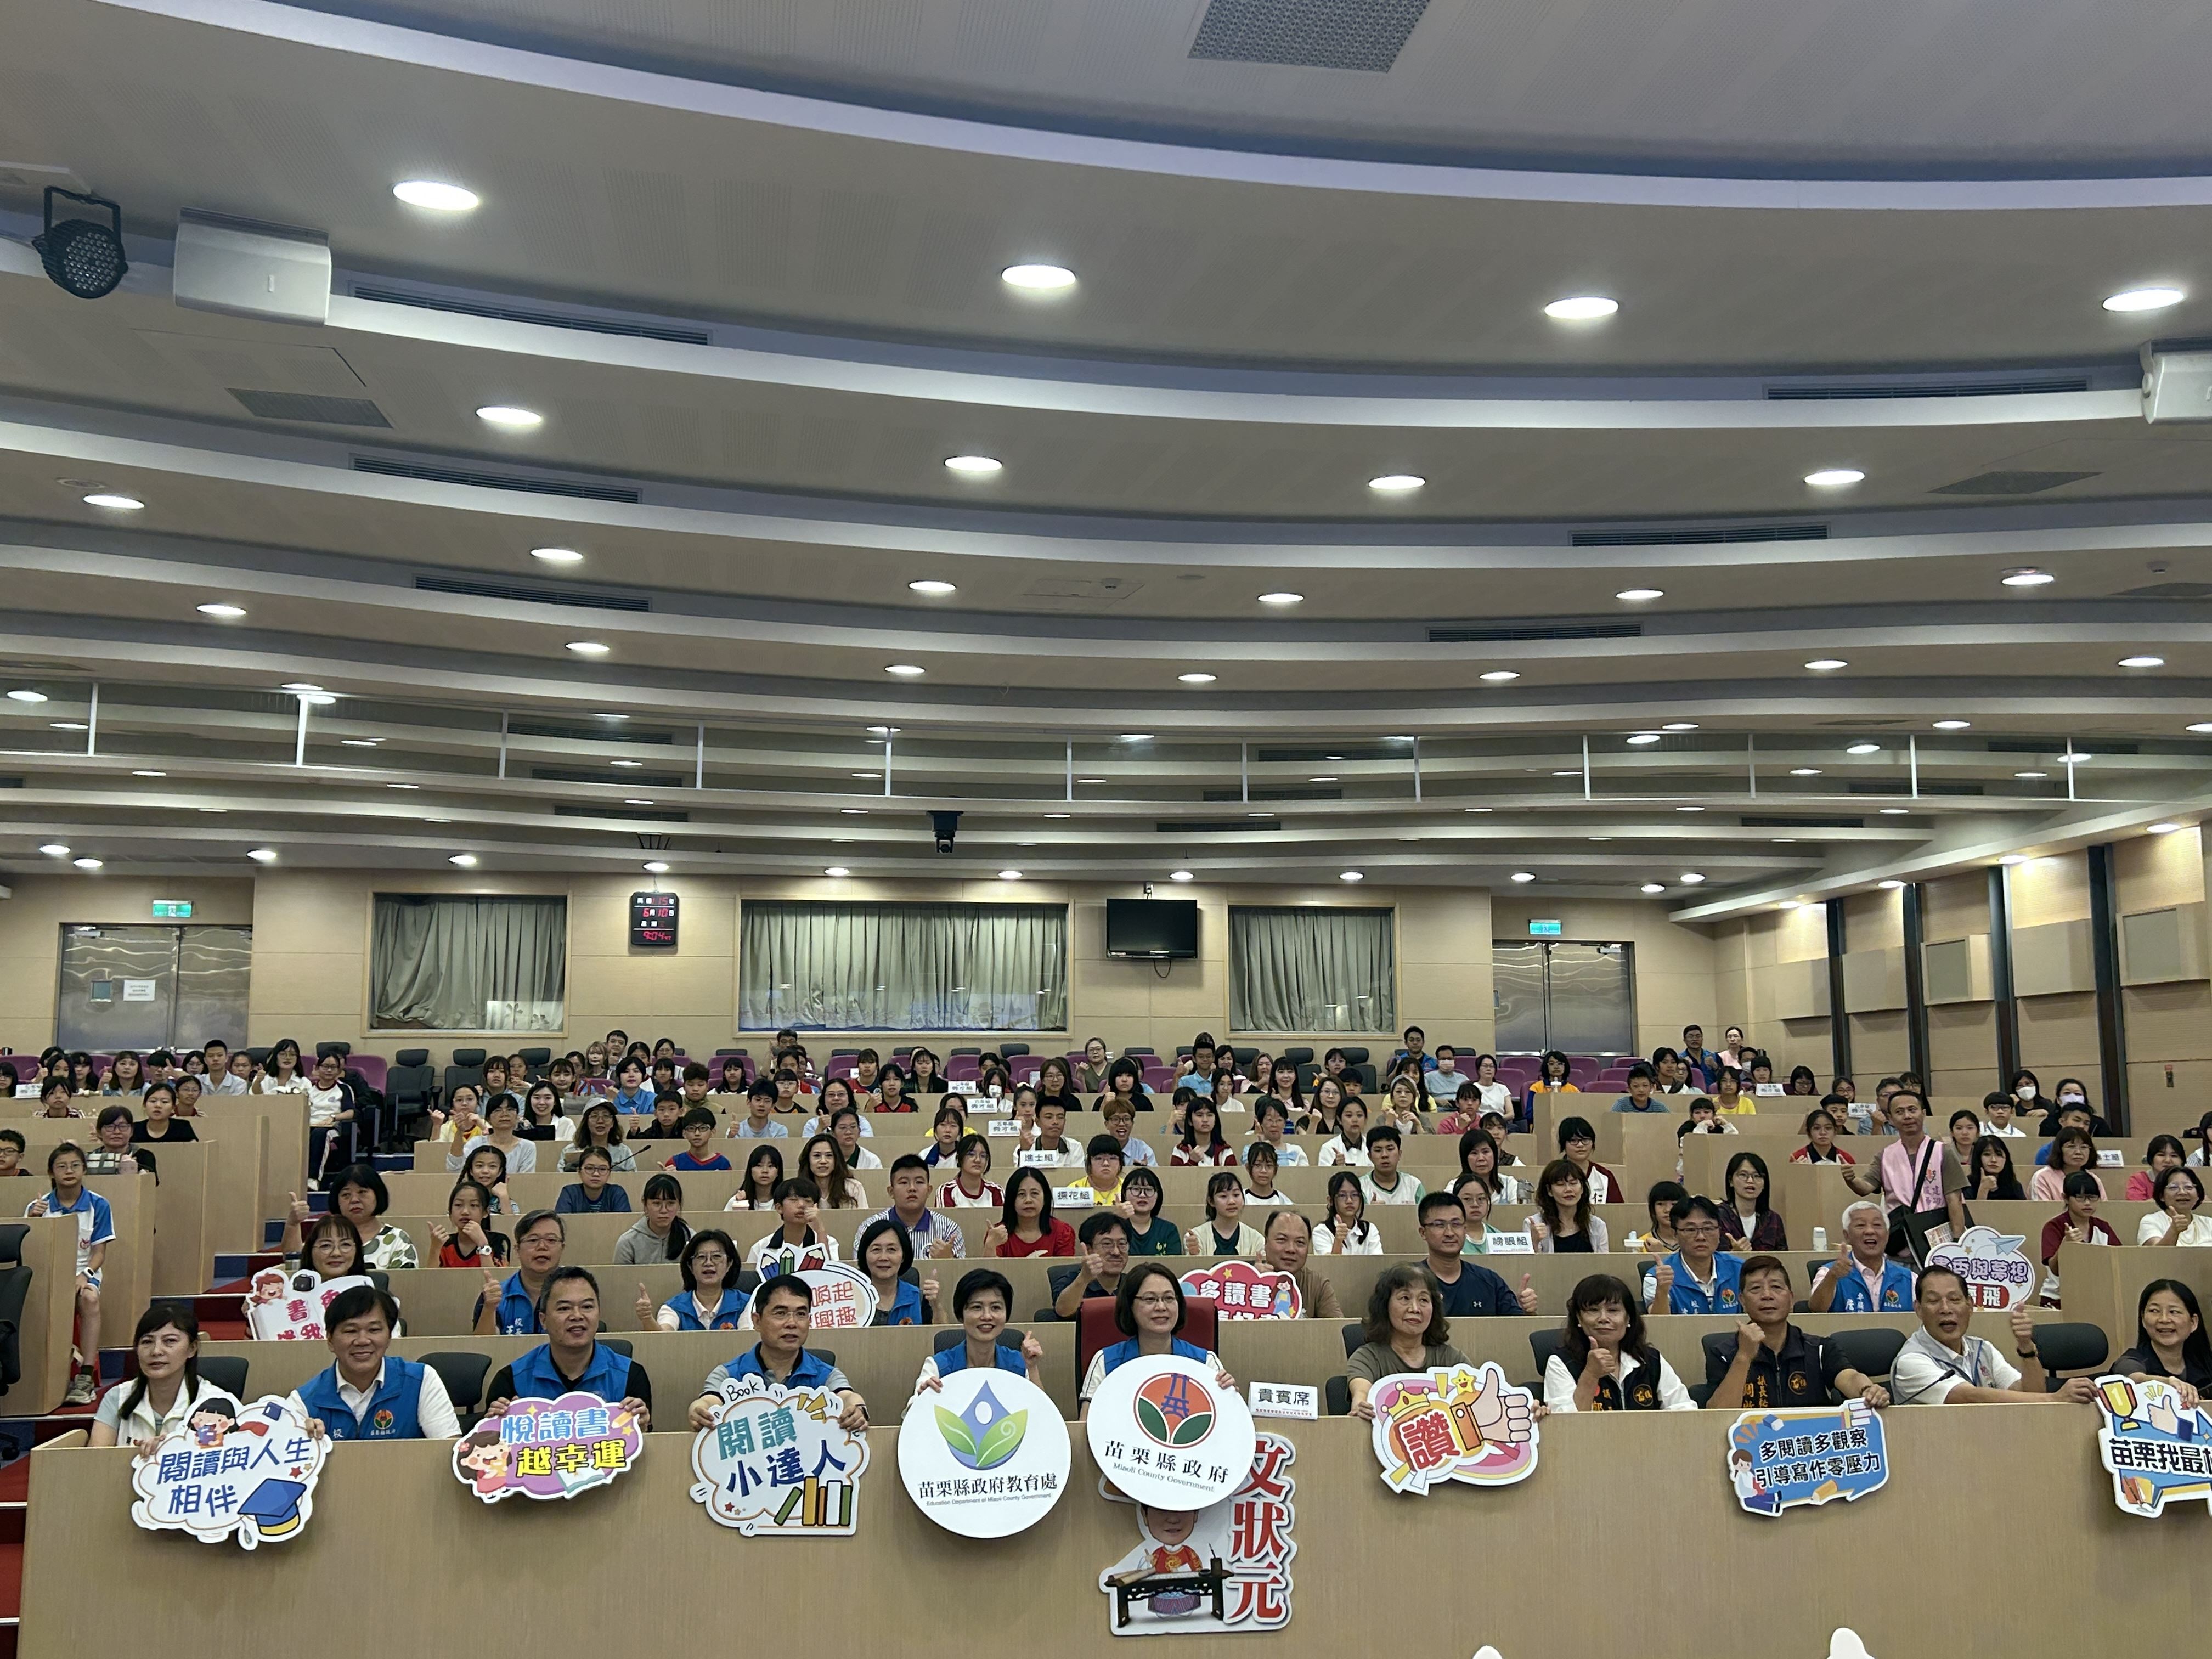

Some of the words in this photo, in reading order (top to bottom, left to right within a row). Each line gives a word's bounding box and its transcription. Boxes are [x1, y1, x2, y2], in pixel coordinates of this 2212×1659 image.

[1024, 1153, 1053, 1162] 進士組
[1057, 1191, 1090, 1200] 探花組
[1492, 1236, 1528, 1246] 榜眼組
[812, 1281, 854, 1307] 喚起
[1200, 1280, 1272, 1308] 多讀書
[809, 1306, 857, 1328] 興趣
[726, 1380, 760, 1401] Book
[1258, 1388, 1310, 1406] 貴賓席
[501, 1409, 608, 1443] 悅讀書
[716, 1406, 797, 1460] 閱讀
[1402, 1412, 1460, 1470] 讚
[156, 1437, 312, 1485] 閱讀與人生
[516, 1438, 627, 1477] 越幸運
[1760, 1428, 1867, 1462] 多閱讀多觀察
[726, 1440, 847, 1497] 小達人
[1105, 1440, 1229, 1483] 苗栗縣政府
[1113, 1462, 1136, 1474] Miaoli
[1138, 1469, 1165, 1481] County
[1167, 1475, 1214, 1492] Government
[1756, 1452, 1881, 1487] 引導寫作零壓力
[168, 1485, 238, 1517] 相伴
[917, 1472, 1058, 1499] 苗栗縣政府教育處
[1229, 1441, 1287, 1618] 文狀元
